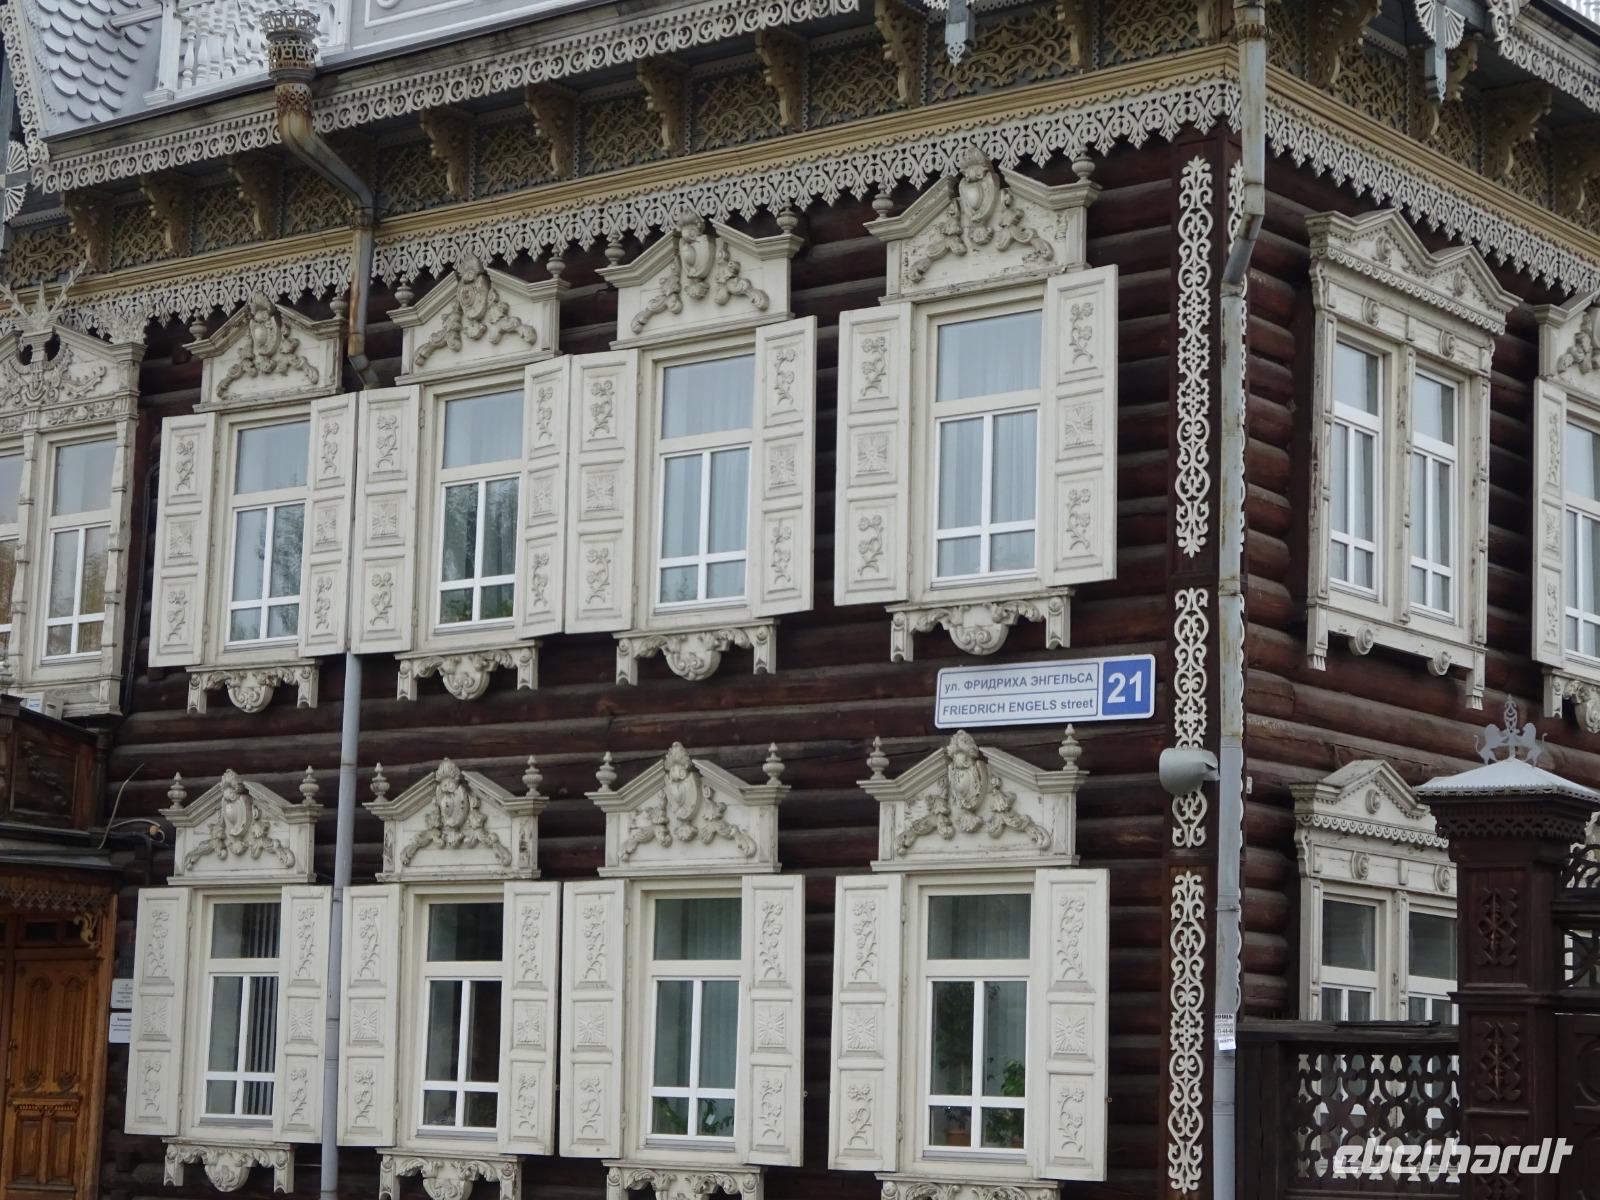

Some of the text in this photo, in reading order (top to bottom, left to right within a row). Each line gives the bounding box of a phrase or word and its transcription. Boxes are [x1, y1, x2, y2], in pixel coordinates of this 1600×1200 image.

[944, 672, 1093, 693] ул. ФРИДРИХА ЭНГЕЛЬСА
[1107, 671, 1143, 704] 21
[942, 698, 1094, 716] FRIEDRICH ENGELS street
